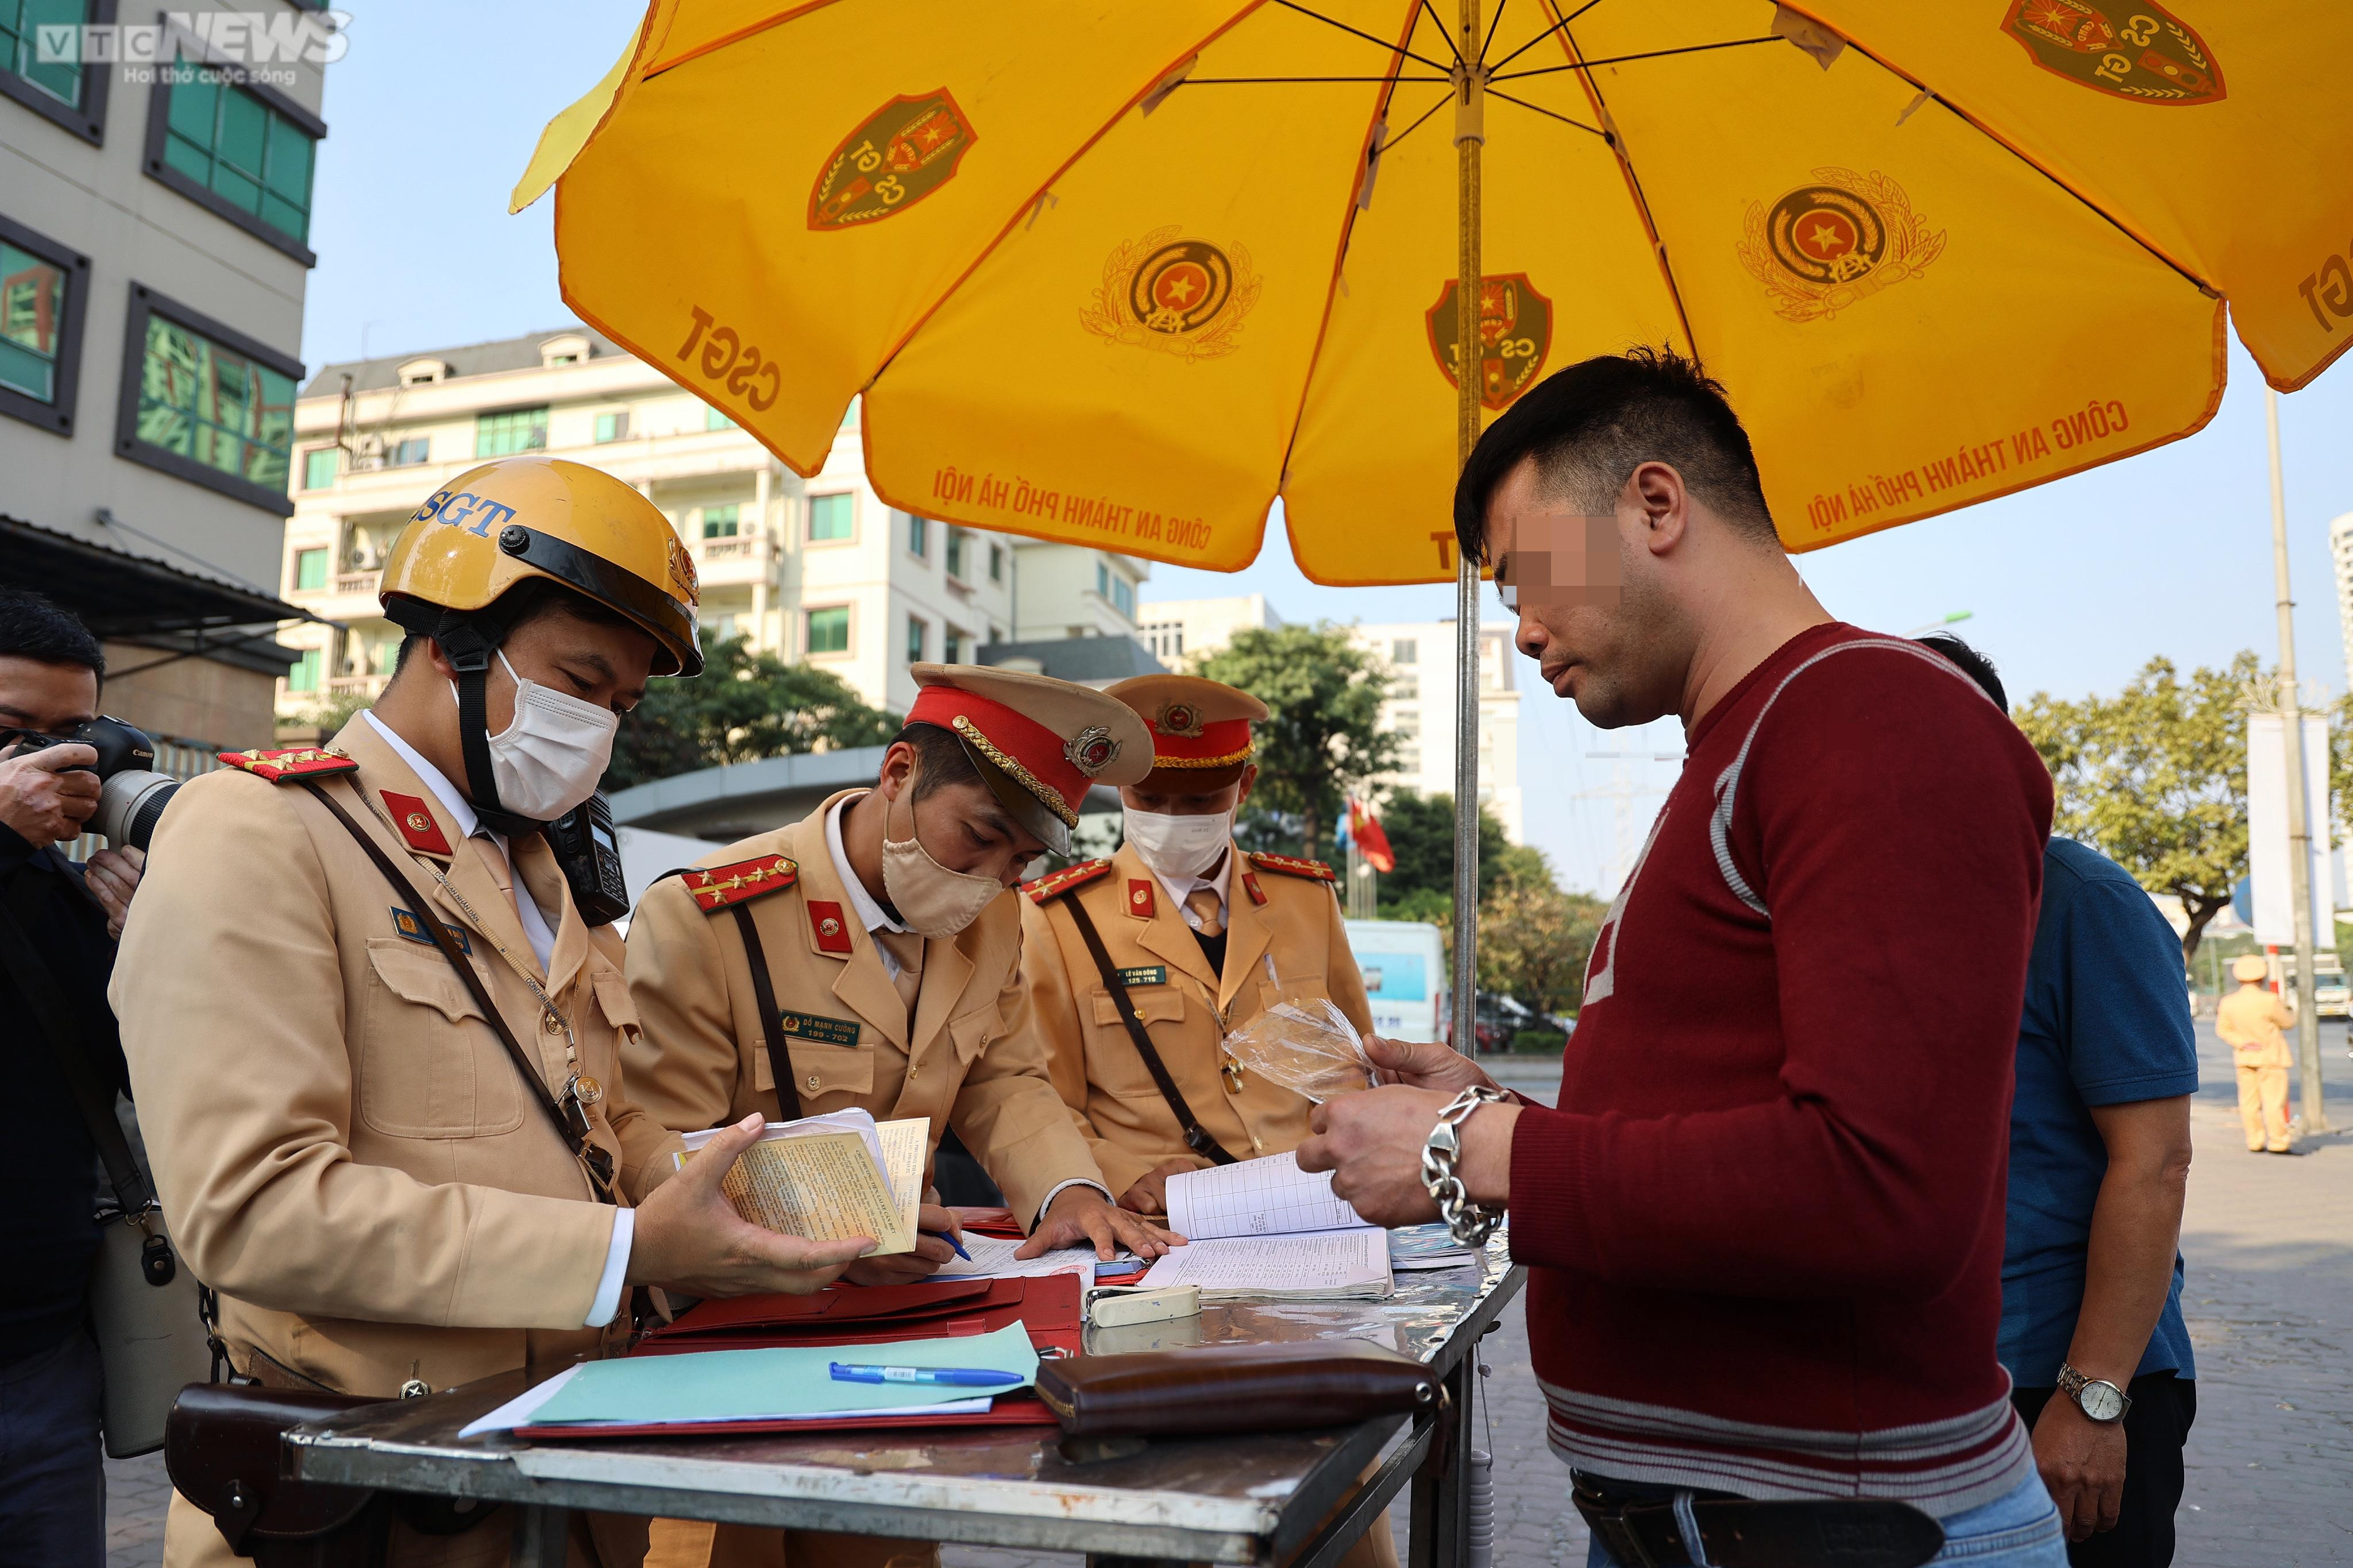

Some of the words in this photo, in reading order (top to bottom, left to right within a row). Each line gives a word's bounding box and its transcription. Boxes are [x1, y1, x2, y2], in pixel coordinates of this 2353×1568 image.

[406, 491, 516, 538] SGT
[133, 749, 153, 758] Canon
[434, 870, 451, 887] CÔNG
[448, 886, 457, 895] AN
[538, 993, 548, 1002] AN
[814, 1021, 832, 1030] MẠNH
[808, 1029, 824, 1038] 199
[832, 1033, 848, 1042] 702
